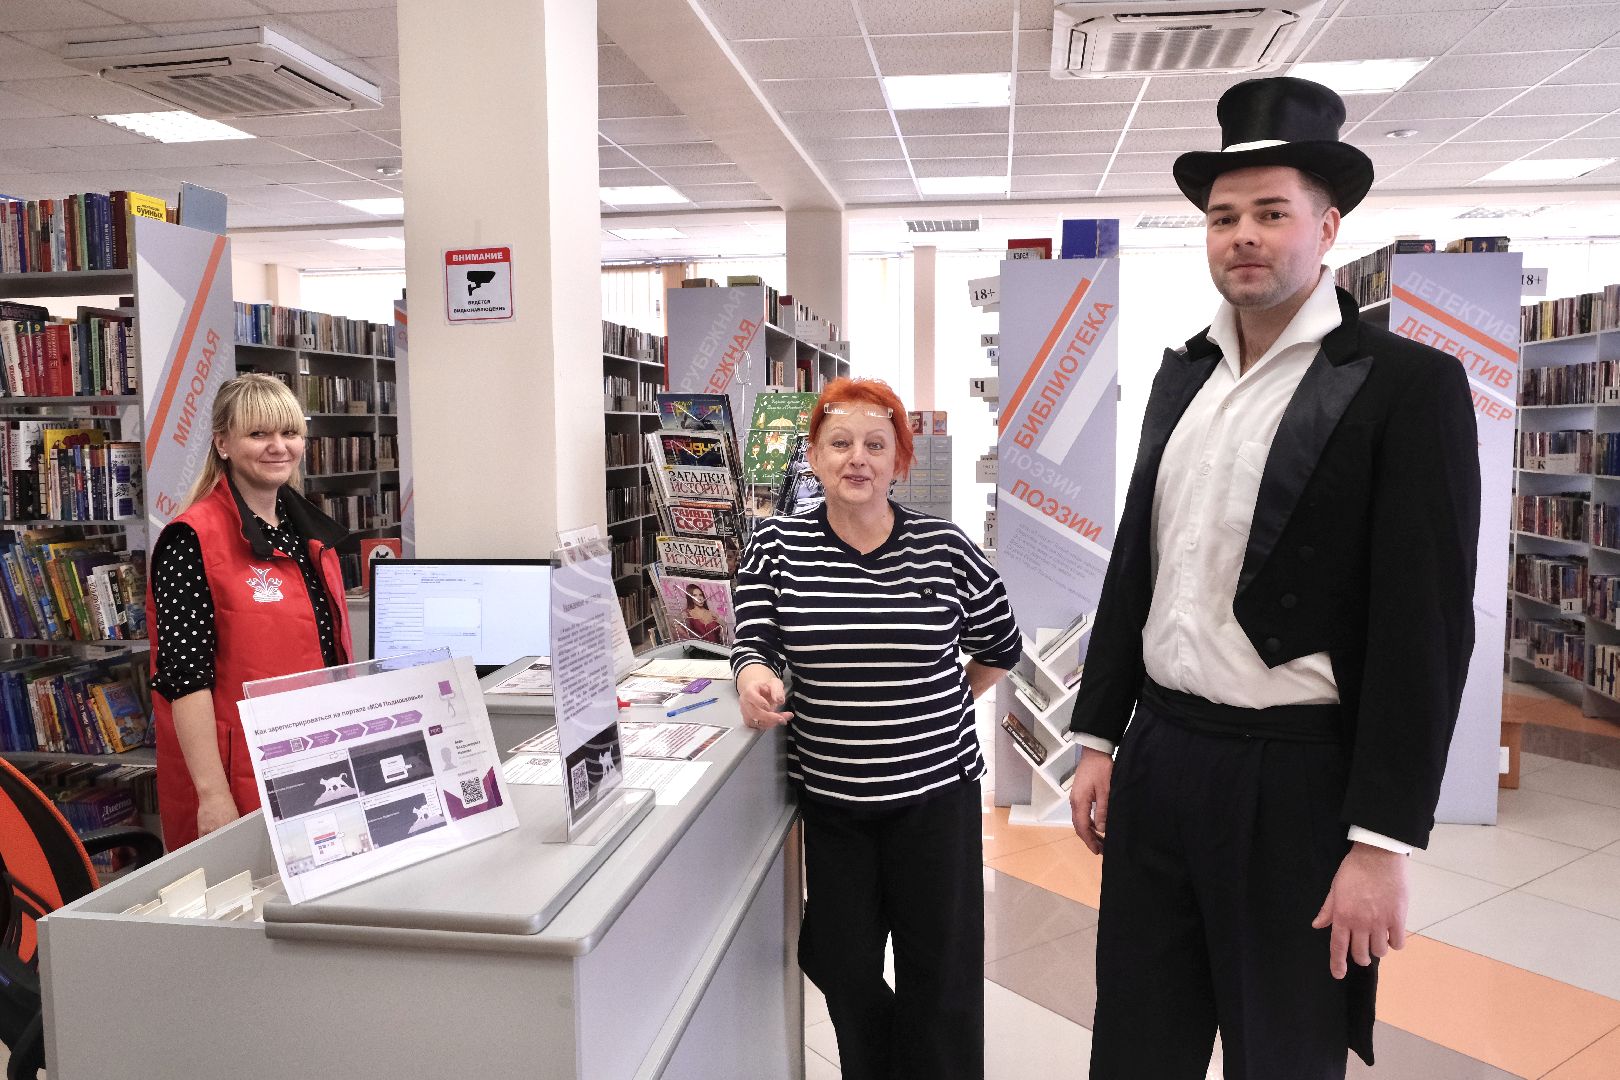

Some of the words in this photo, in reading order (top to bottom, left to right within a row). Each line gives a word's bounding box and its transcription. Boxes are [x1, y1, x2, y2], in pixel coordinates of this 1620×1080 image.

[452, 252, 503, 262] ВНИМАНИЕ
[974, 288, 996, 301] 18+
[1401, 271, 1519, 341] ДЕТЕКТИВ
[680, 288, 746, 394] РУБЕЖНАЯ
[1395, 315, 1513, 389] ДЕТЕКТИВ
[1013, 301, 1114, 449] БИБЛИОТЕКА
[172, 328, 220, 449] МИРОВАЯ
[974, 380, 985, 393] Ч
[668, 471, 727, 484] ЗАГАДКИ
[1004, 445, 1083, 500] ПОЭЗИИ
[672, 507, 712, 518] ТАЙНЫ
[1010, 478, 1103, 542] ПОЭЗИИ
[675, 516, 714, 532] СССР
[986, 523, 994, 531] Р
[664, 542, 721, 557] ЗАГАДКИ
[665, 552, 723, 569] ИСТОРИИ
[254, 728, 268, 736] Как
